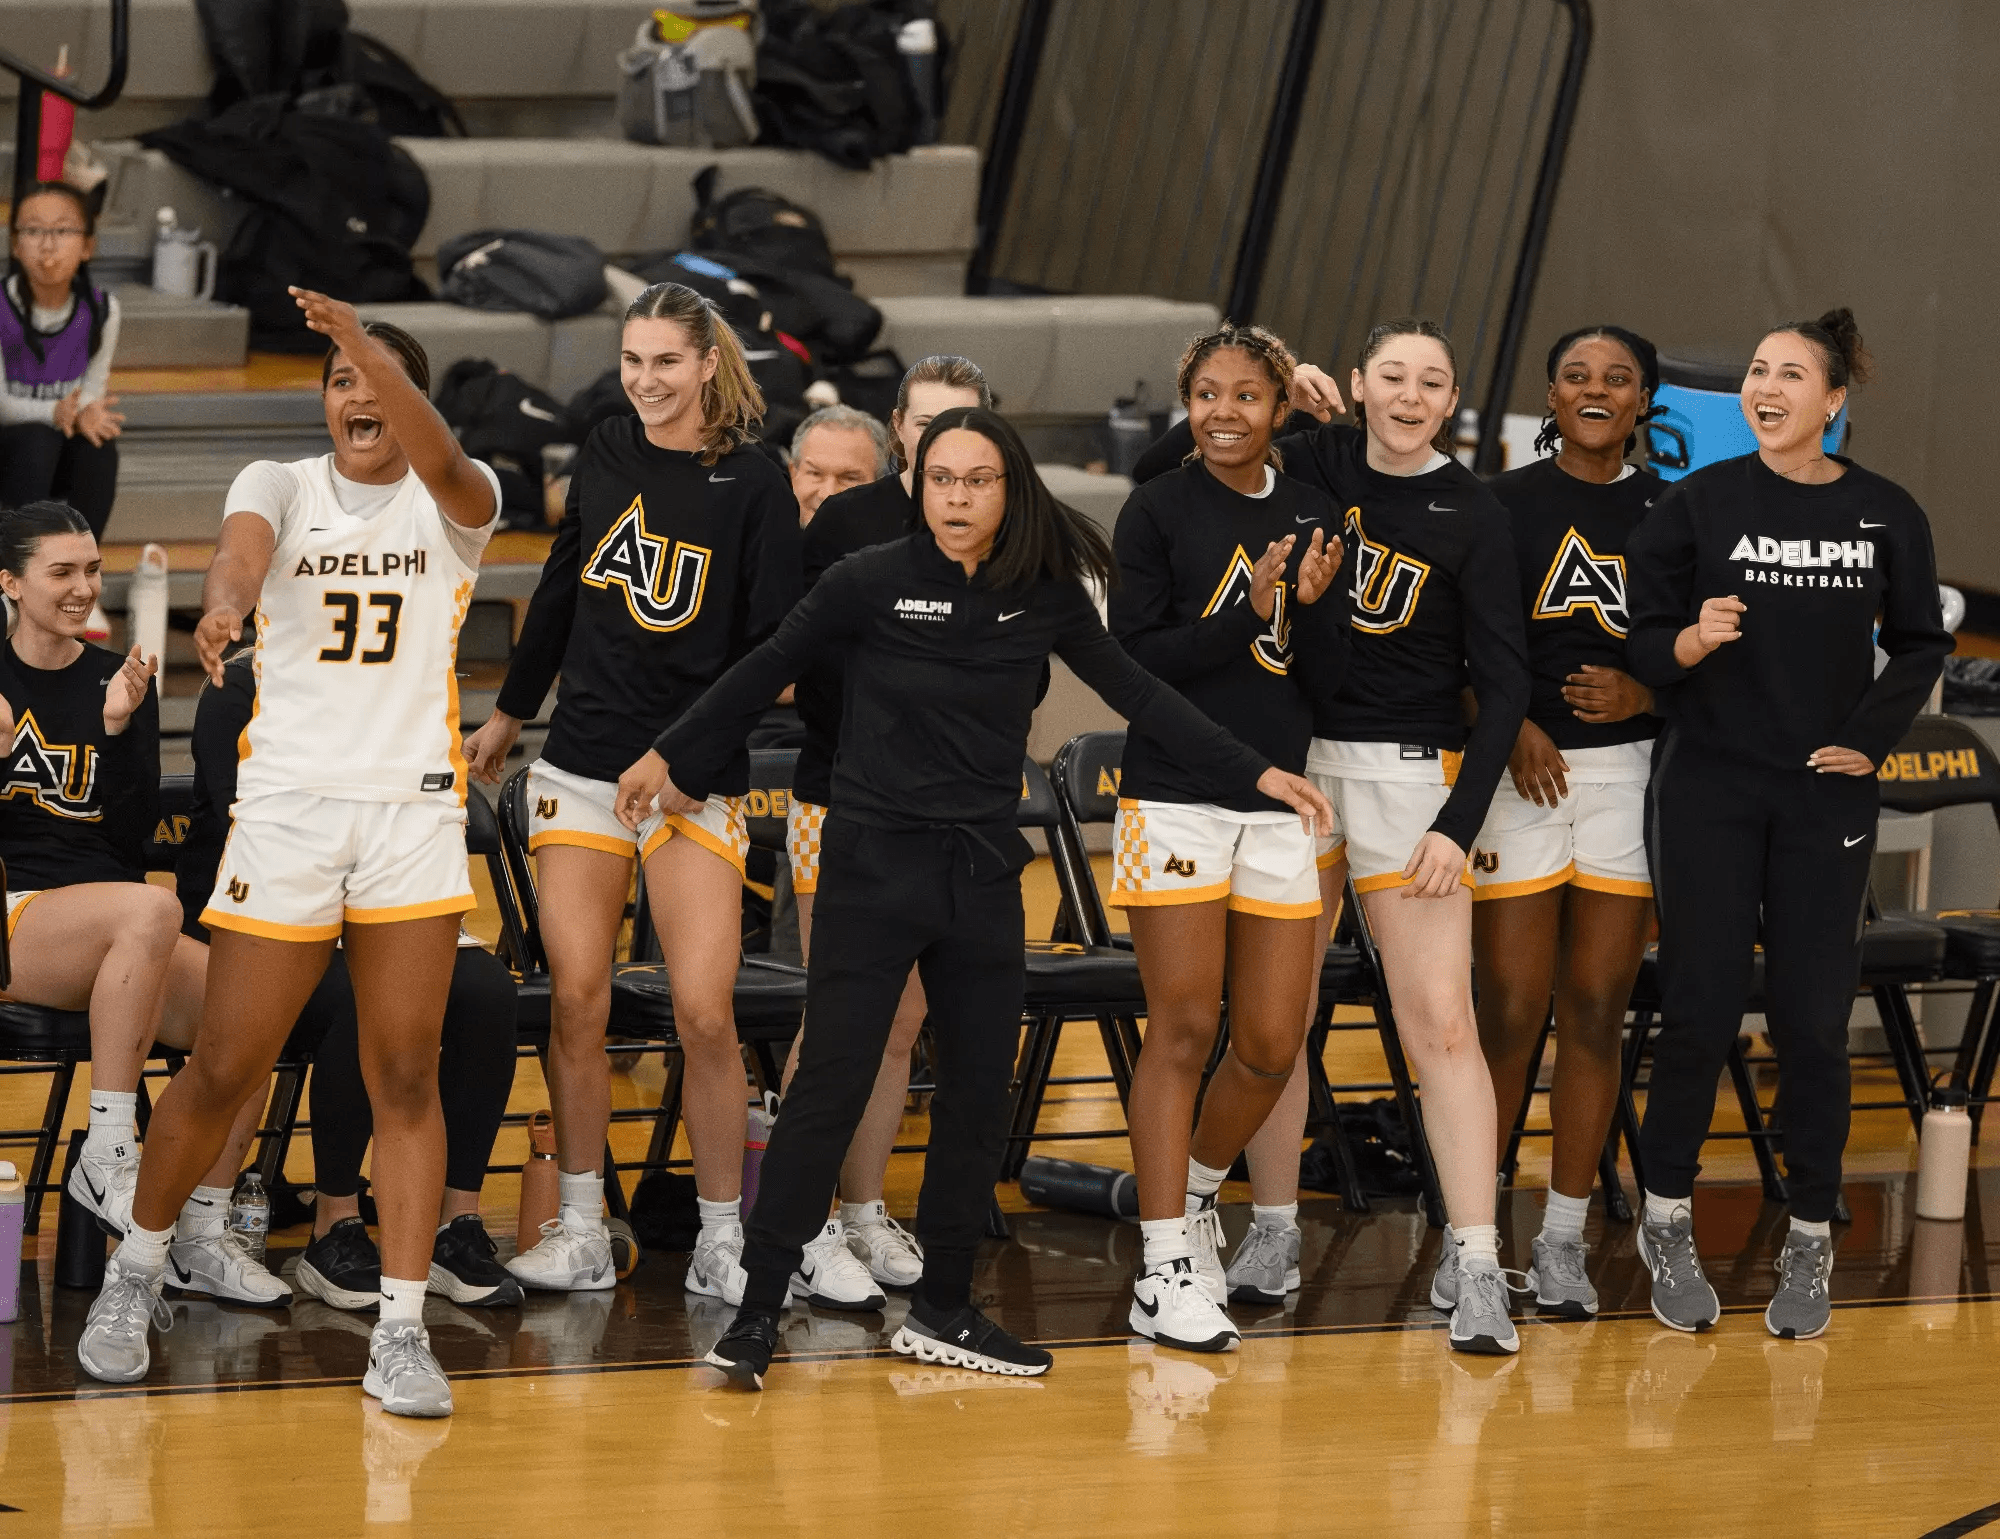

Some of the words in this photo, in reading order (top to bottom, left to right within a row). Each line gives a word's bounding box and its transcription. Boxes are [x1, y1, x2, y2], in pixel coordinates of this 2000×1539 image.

[294, 549, 426, 577] ADELPHI
[580, 492, 713, 633] AU
[1728, 533, 1875, 569] ADELPHI
[1344, 506, 1432, 635] U
[1744, 568, 1864, 588] BASKETBALL
[893, 597, 953, 615] ADELPHI
[899, 612, 946, 622] BASKETBALL
[317, 589, 405, 666] 33
[0, 707, 104, 823] AU
[1876, 748, 1980, 782] DELPHI
[534, 793, 558, 820] AU
[1163, 852, 1197, 878] AU
[1472, 847, 1499, 874] AU
[224, 873, 251, 904] AU
